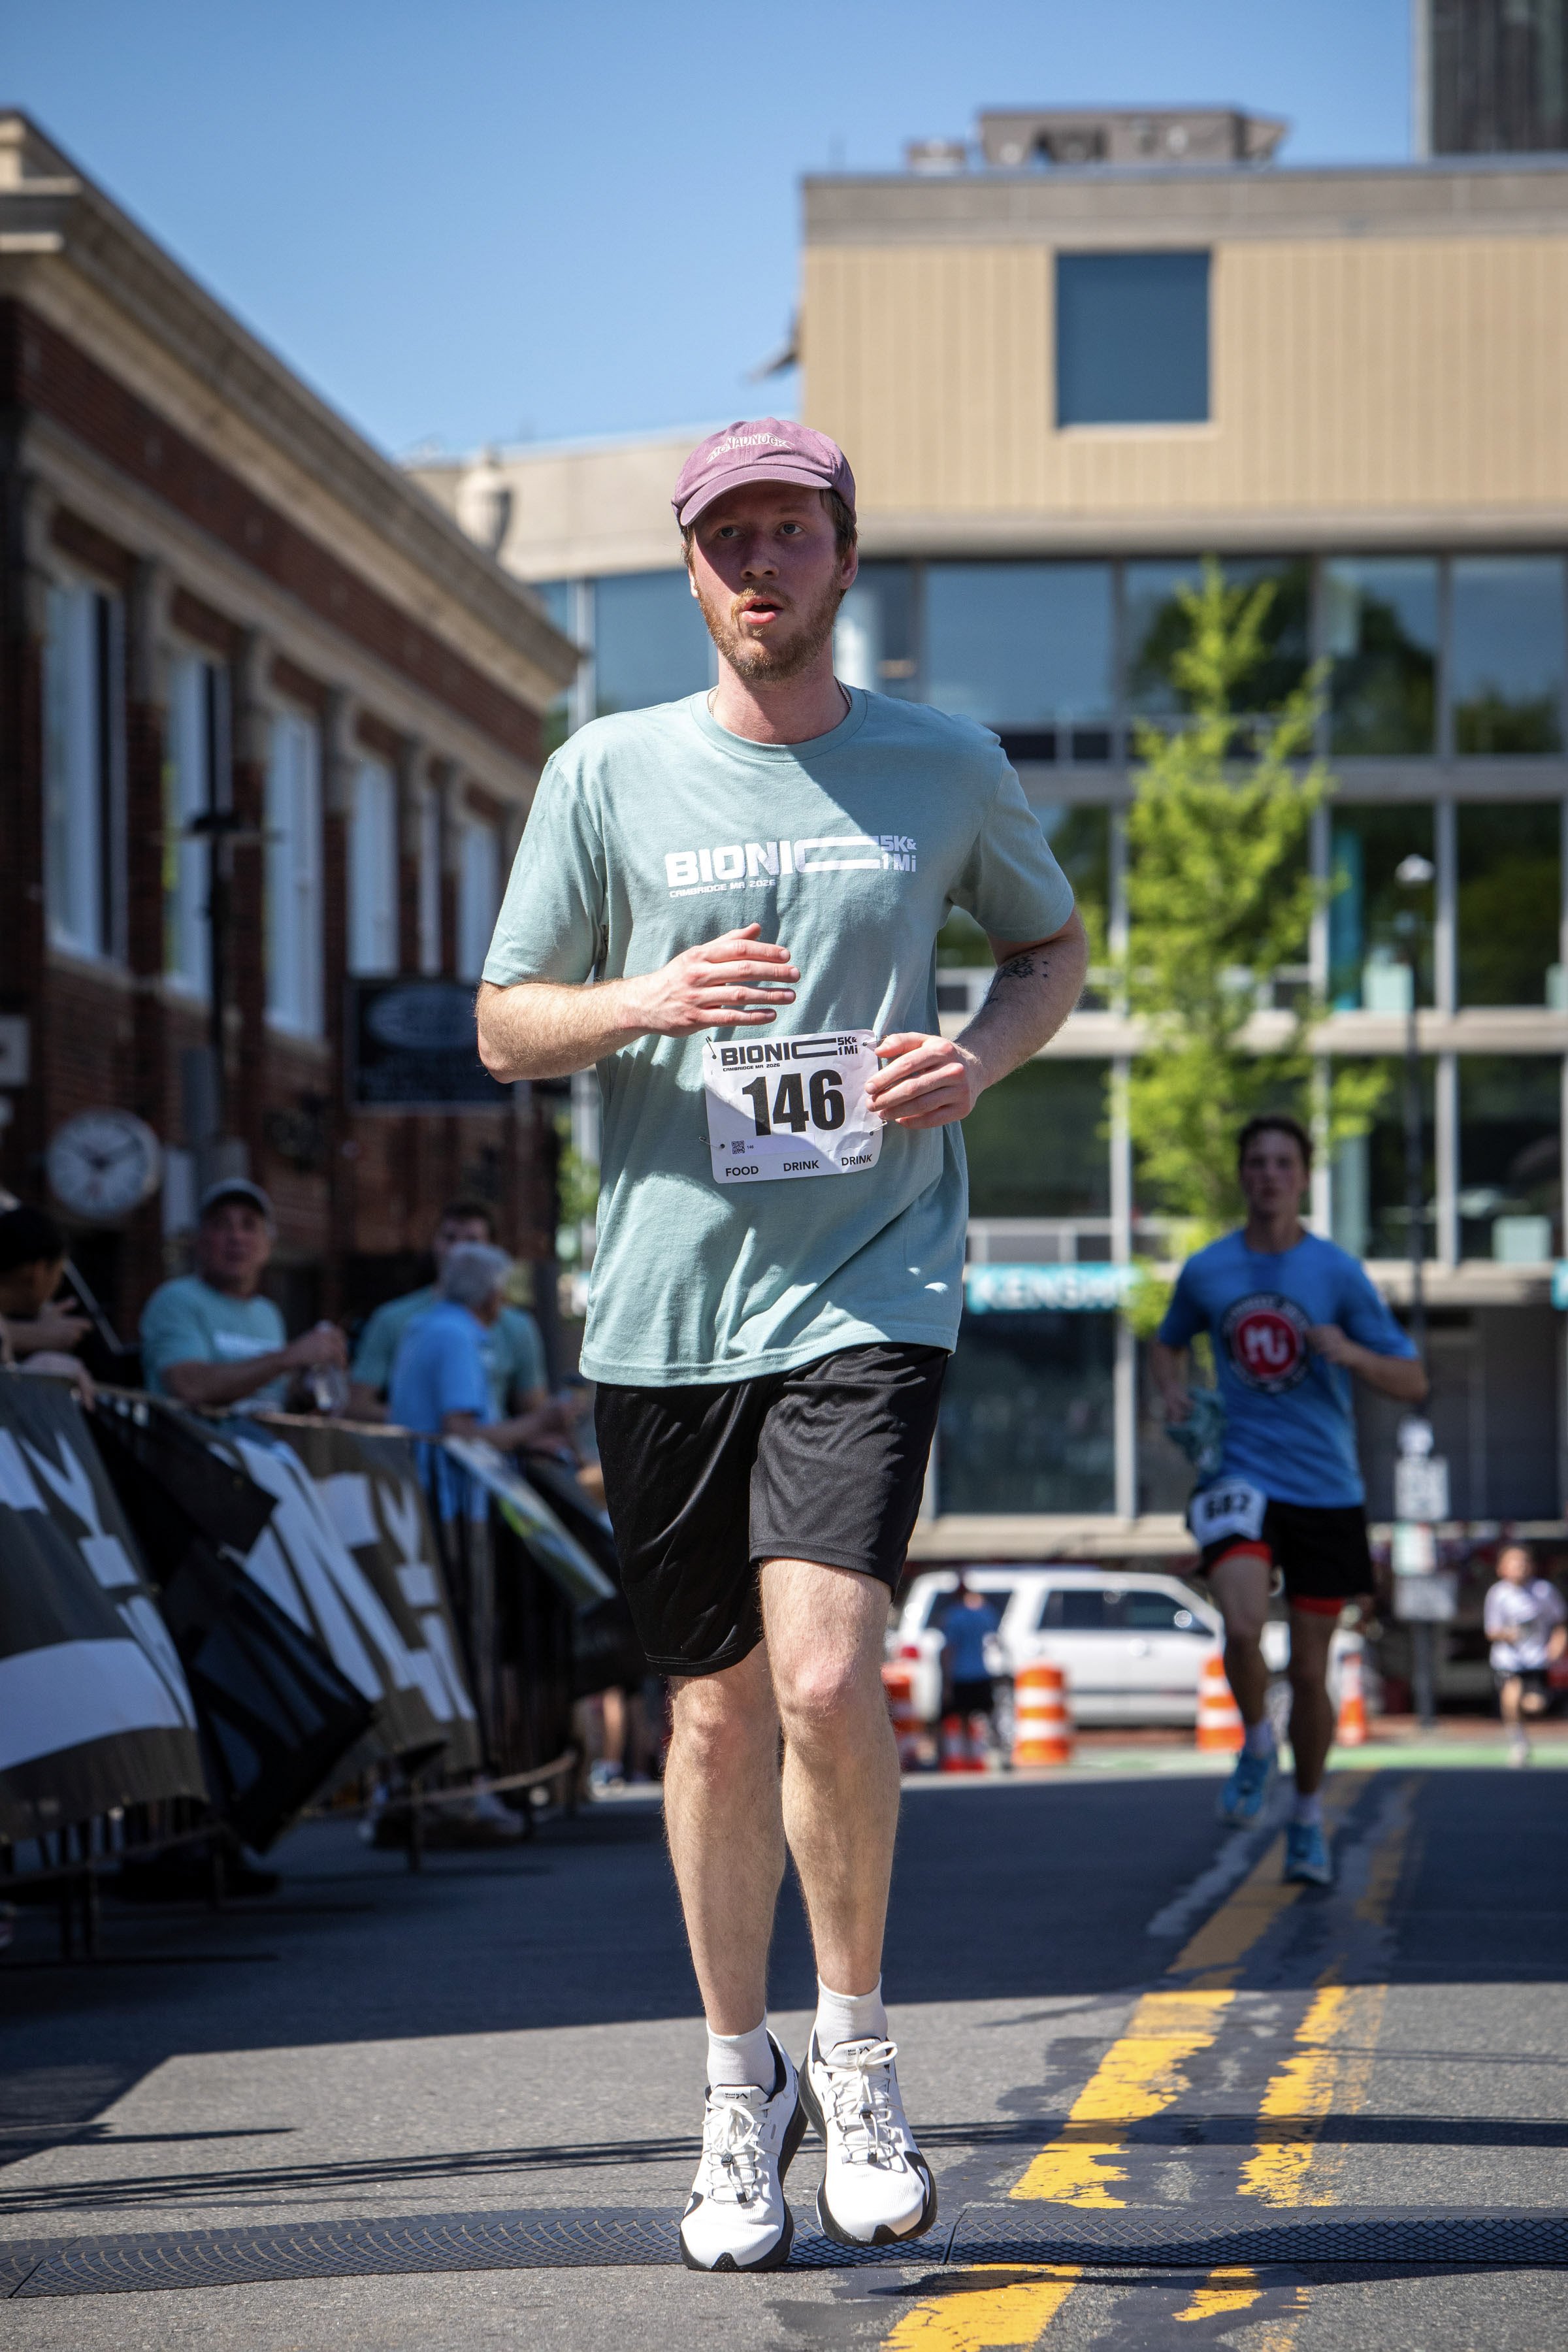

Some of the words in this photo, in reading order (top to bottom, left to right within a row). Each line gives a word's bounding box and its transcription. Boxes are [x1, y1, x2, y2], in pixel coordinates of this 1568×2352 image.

[881, 836, 917, 852] 5K&
[664, 836, 880, 887] BIONIC
[670, 884, 727, 898] CAMBRIDGE
[730, 881, 745, 890] MA
[749, 879, 776, 888] 2026
[721, 1037, 838, 1066] BIONIC
[837, 1036, 857, 1046] 5K&
[742, 1070, 845, 1136] 146
[725, 1166, 759, 1177] FOOD
[783, 1160, 819, 1172] DRINK
[841, 1154, 873, 1166] DRINK
